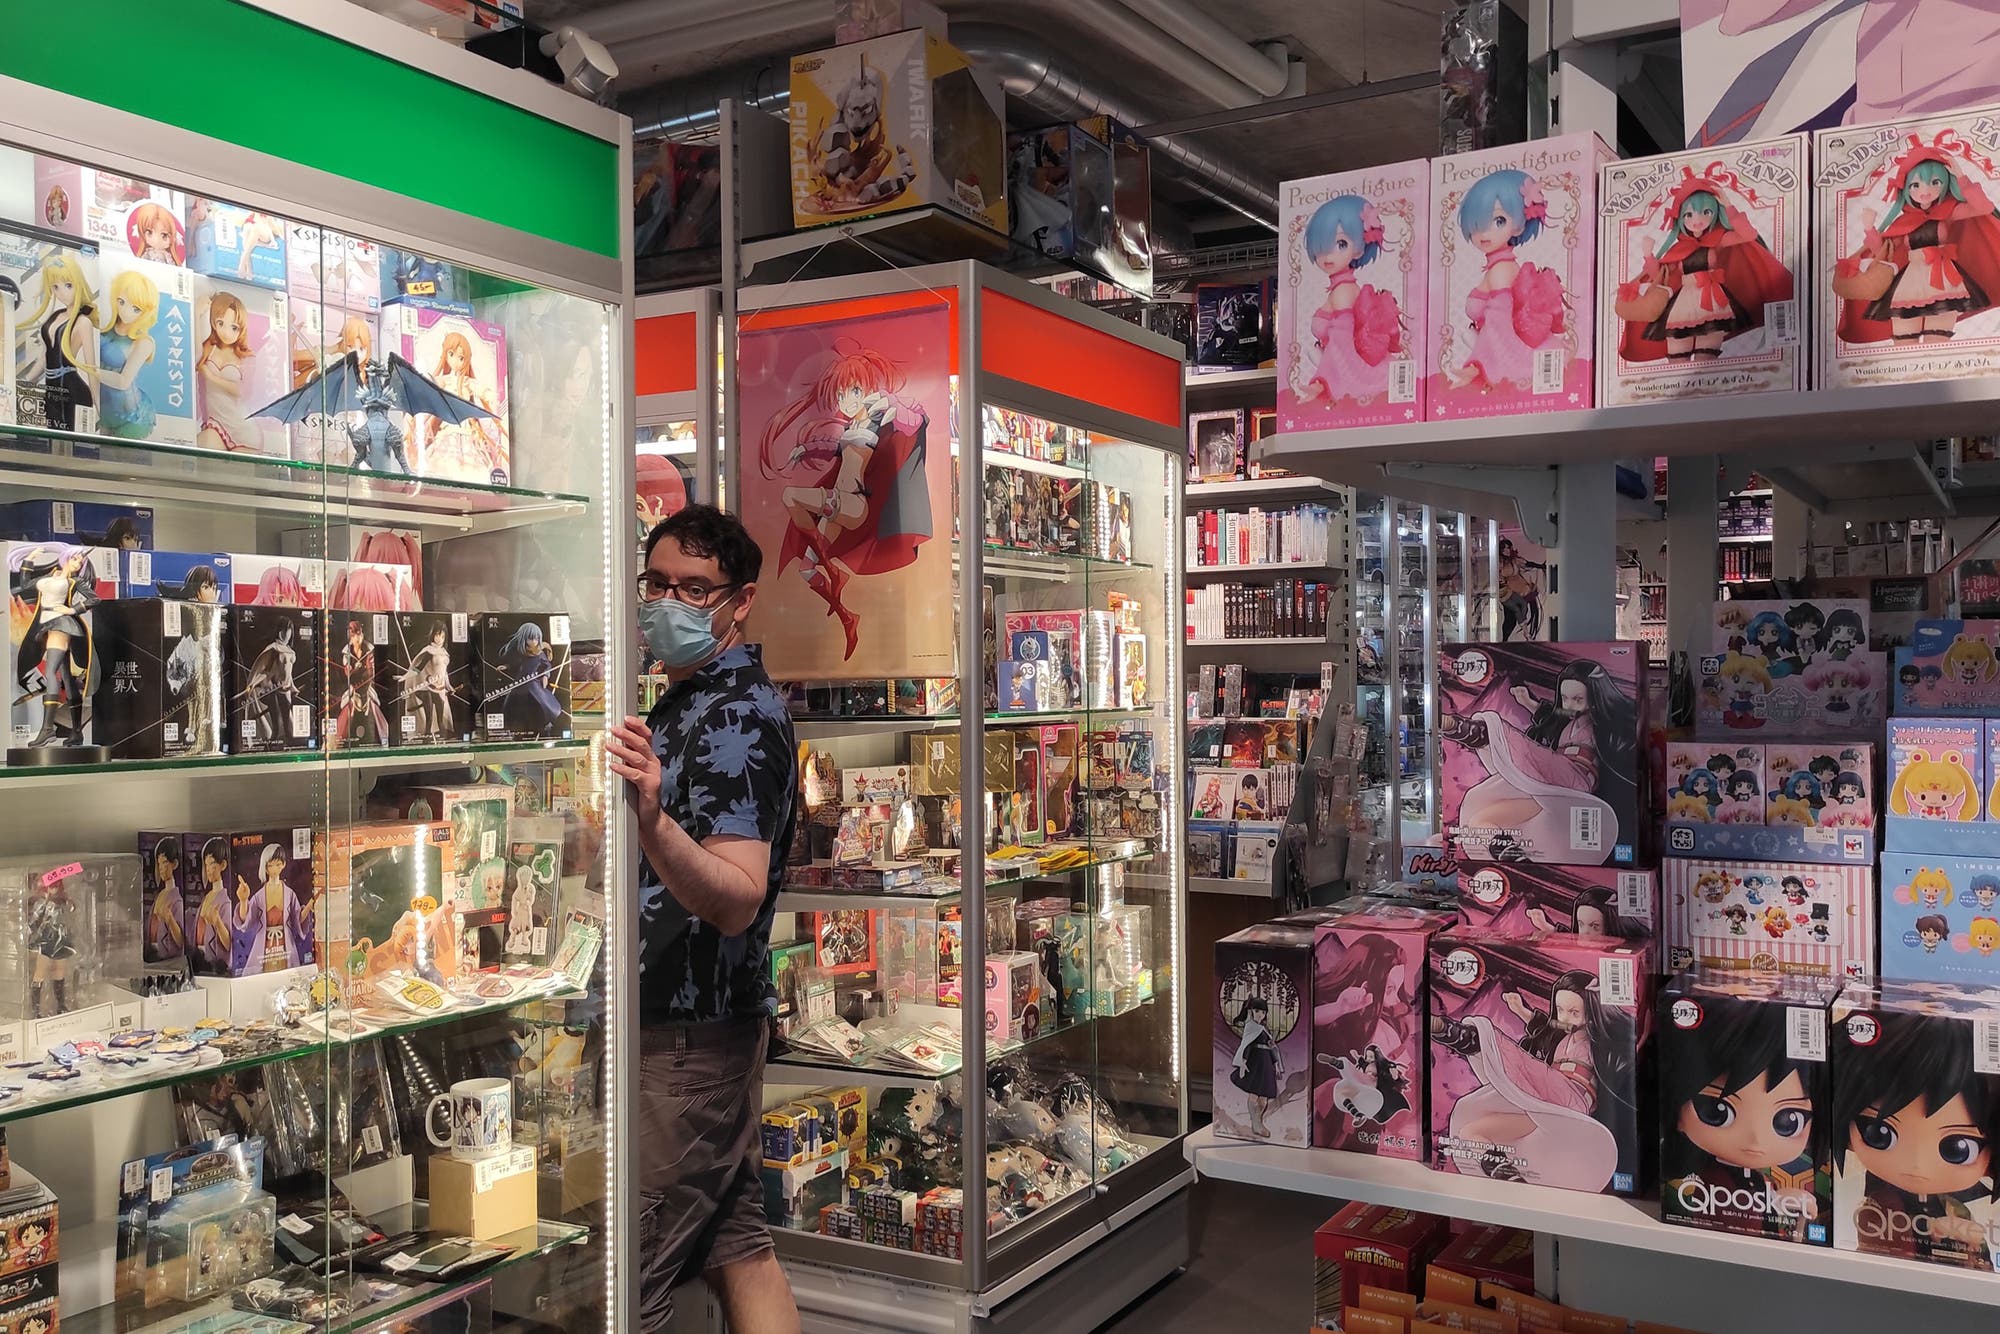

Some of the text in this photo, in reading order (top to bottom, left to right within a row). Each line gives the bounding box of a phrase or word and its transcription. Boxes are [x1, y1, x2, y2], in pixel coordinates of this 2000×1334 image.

[908, 58, 926, 140] IWARK
[1441, 149, 1581, 185] Precious figure
[1817, 129, 1898, 186] WONDER
[1288, 176, 1416, 209] Precious figure
[1602, 152, 1796, 215] WONDER LAND
[88, 219, 118, 236] 1343
[1854, 364, 1908, 376] Wonderland
[1634, 381, 1681, 393] Wonderland
[1503, 828, 1522, 837] STARS
[1410, 853, 1458, 877] Kirby
[1495, 1143, 1516, 1154] STARS
[1677, 1178, 1812, 1220] Qposket
[1353, 1250, 1372, 1264] HERO
